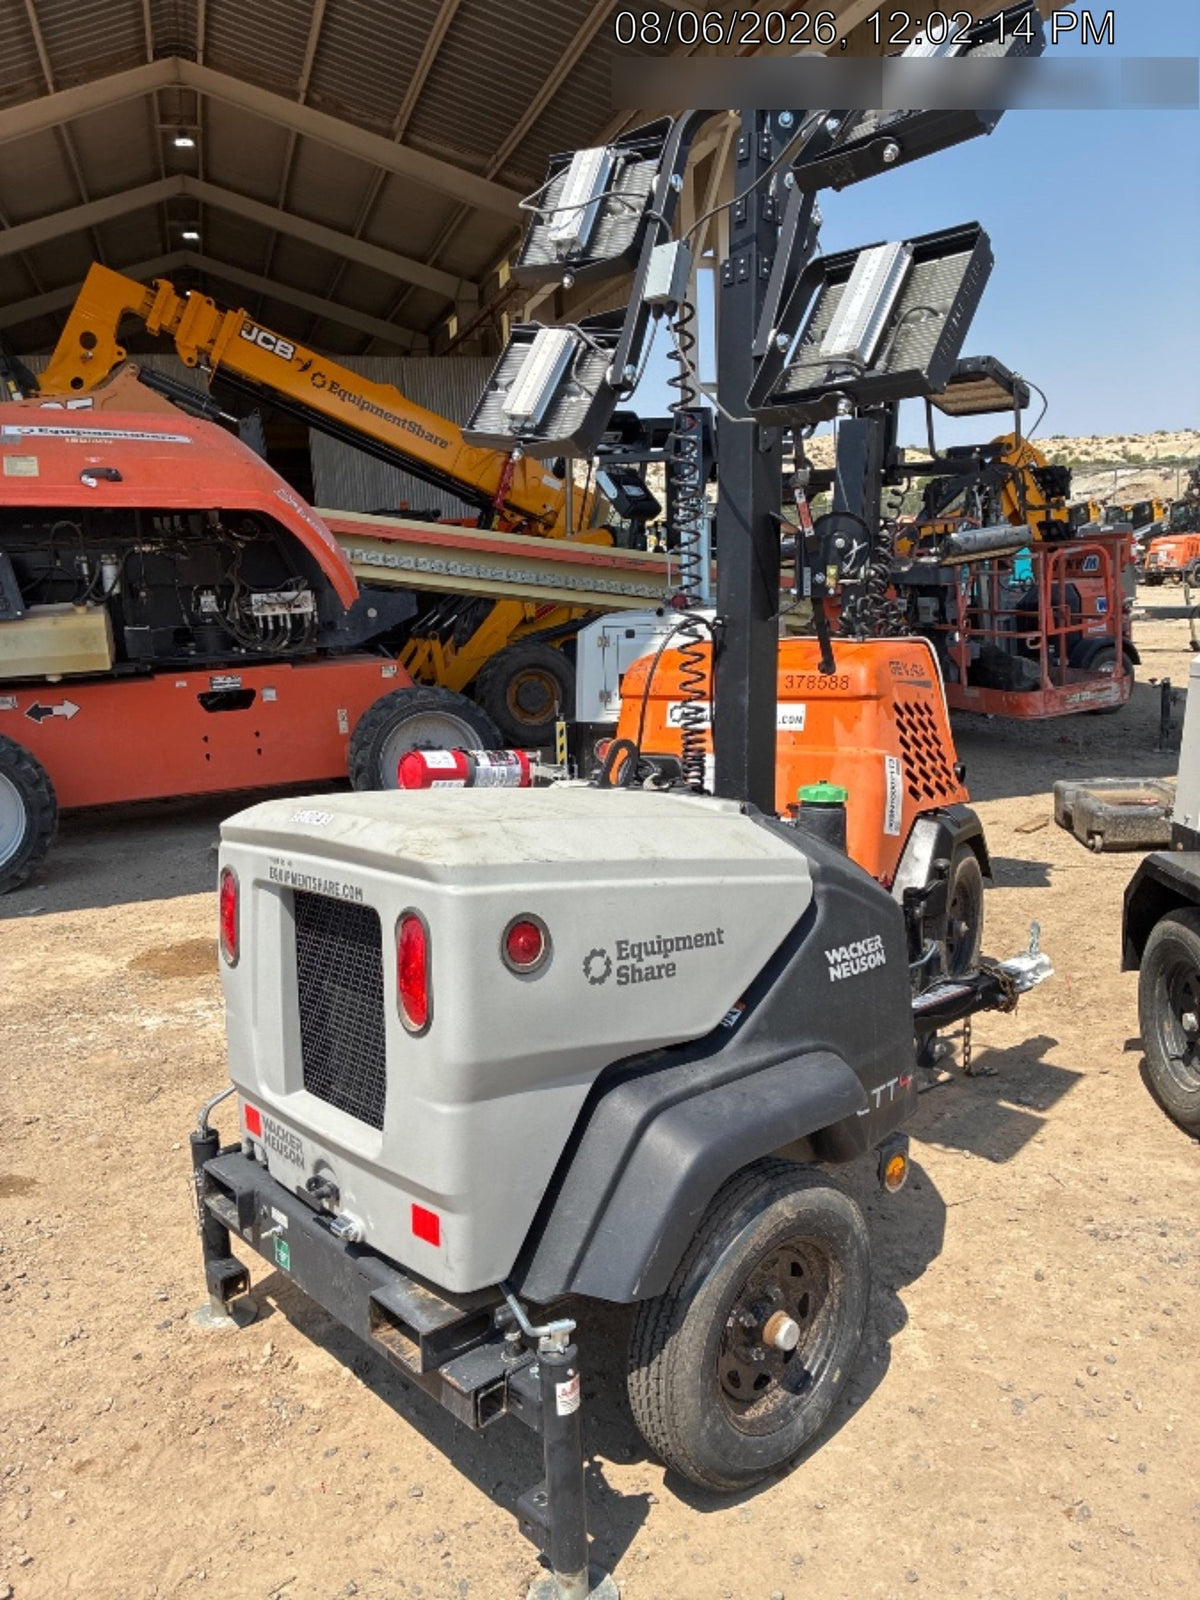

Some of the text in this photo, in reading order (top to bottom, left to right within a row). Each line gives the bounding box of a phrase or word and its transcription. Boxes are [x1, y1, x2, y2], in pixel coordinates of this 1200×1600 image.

[241, 325, 295, 360] JCB
[327, 380, 450, 449] EquipmentShare
[784, 674, 850, 691] 378588
[269, 866, 363, 901] EQUIPMENTSHARE.COM
[615, 927, 724, 962] Equipment
[824, 934, 884, 965] WACKER
[616, 962, 676, 986] Share
[828, 949, 887, 983] NEUSON
[261, 1113, 304, 1155] WACKER
[263, 1131, 305, 1170] NEUSON
